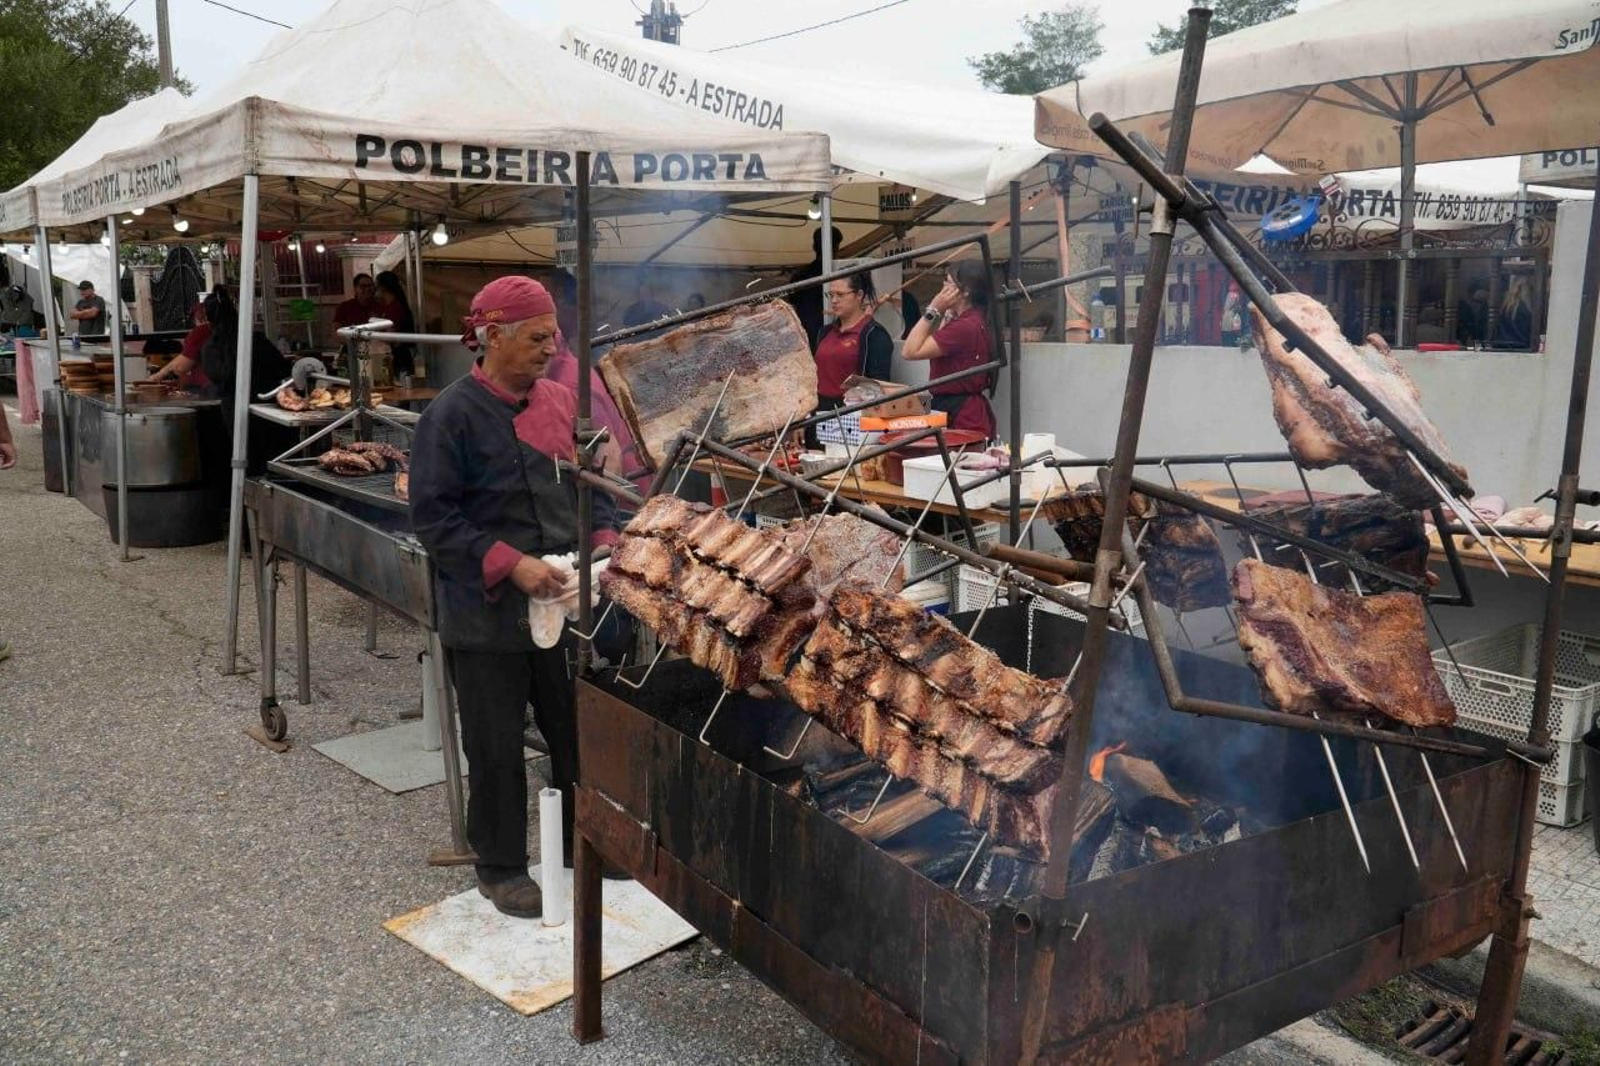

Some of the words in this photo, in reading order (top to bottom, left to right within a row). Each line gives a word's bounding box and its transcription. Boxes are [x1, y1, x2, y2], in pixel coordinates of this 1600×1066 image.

[593, 48, 618, 73] 659
[618, 56, 637, 82] 90
[638, 62, 658, 89] 87
[658, 69, 677, 98] 45
[686, 78, 698, 106] A
[701, 82, 784, 131] ESTRADA
[135, 155, 182, 198] ESTRADA
[355, 133, 619, 186] POLBEIRA
[633, 151, 771, 184] PORTA
